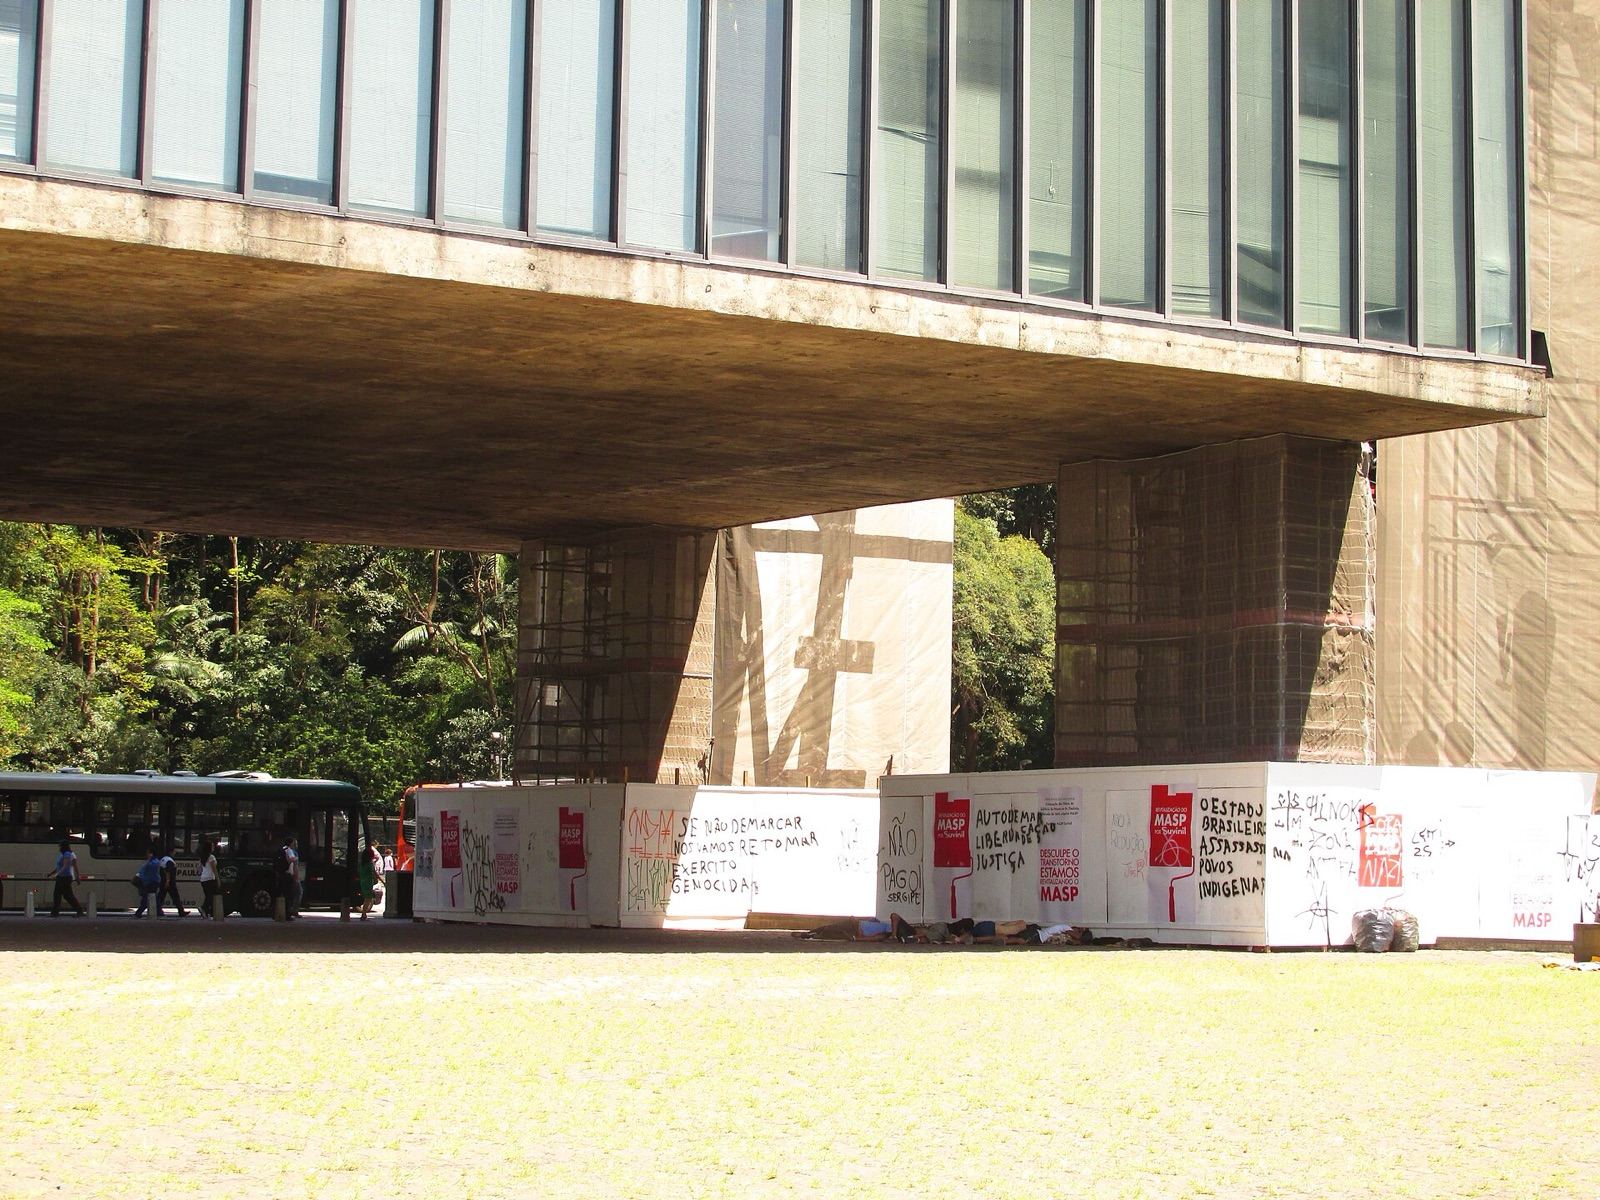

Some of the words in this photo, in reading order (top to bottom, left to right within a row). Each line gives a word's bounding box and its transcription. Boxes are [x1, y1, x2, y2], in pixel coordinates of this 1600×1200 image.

[937, 818, 966, 831] MASP
[1154, 813, 1187, 826] MASP
[561, 828, 581, 838] MASP
[678, 817, 699, 837] SE
[731, 816, 803, 834] DEMARCAR
[1161, 826, 1187, 835] Suvinil
[443, 830, 458, 841] MASP
[1040, 849, 1071, 858] DESCULPE
[1071, 848, 1079, 858] O
[672, 859, 737, 879] EXERCITO
[976, 851, 1026, 874] JUSTIÇA
[1040, 858, 1079, 867] TRANSTORNO
[1199, 859, 1233, 876] POVOS
[1040, 867, 1079, 878] ESTAMOS
[496, 881, 519, 894] MASP
[1040, 886, 1079, 902] MASP
[887, 891, 921, 906] SERGIPE
[1513, 912, 1552, 928] MASP
